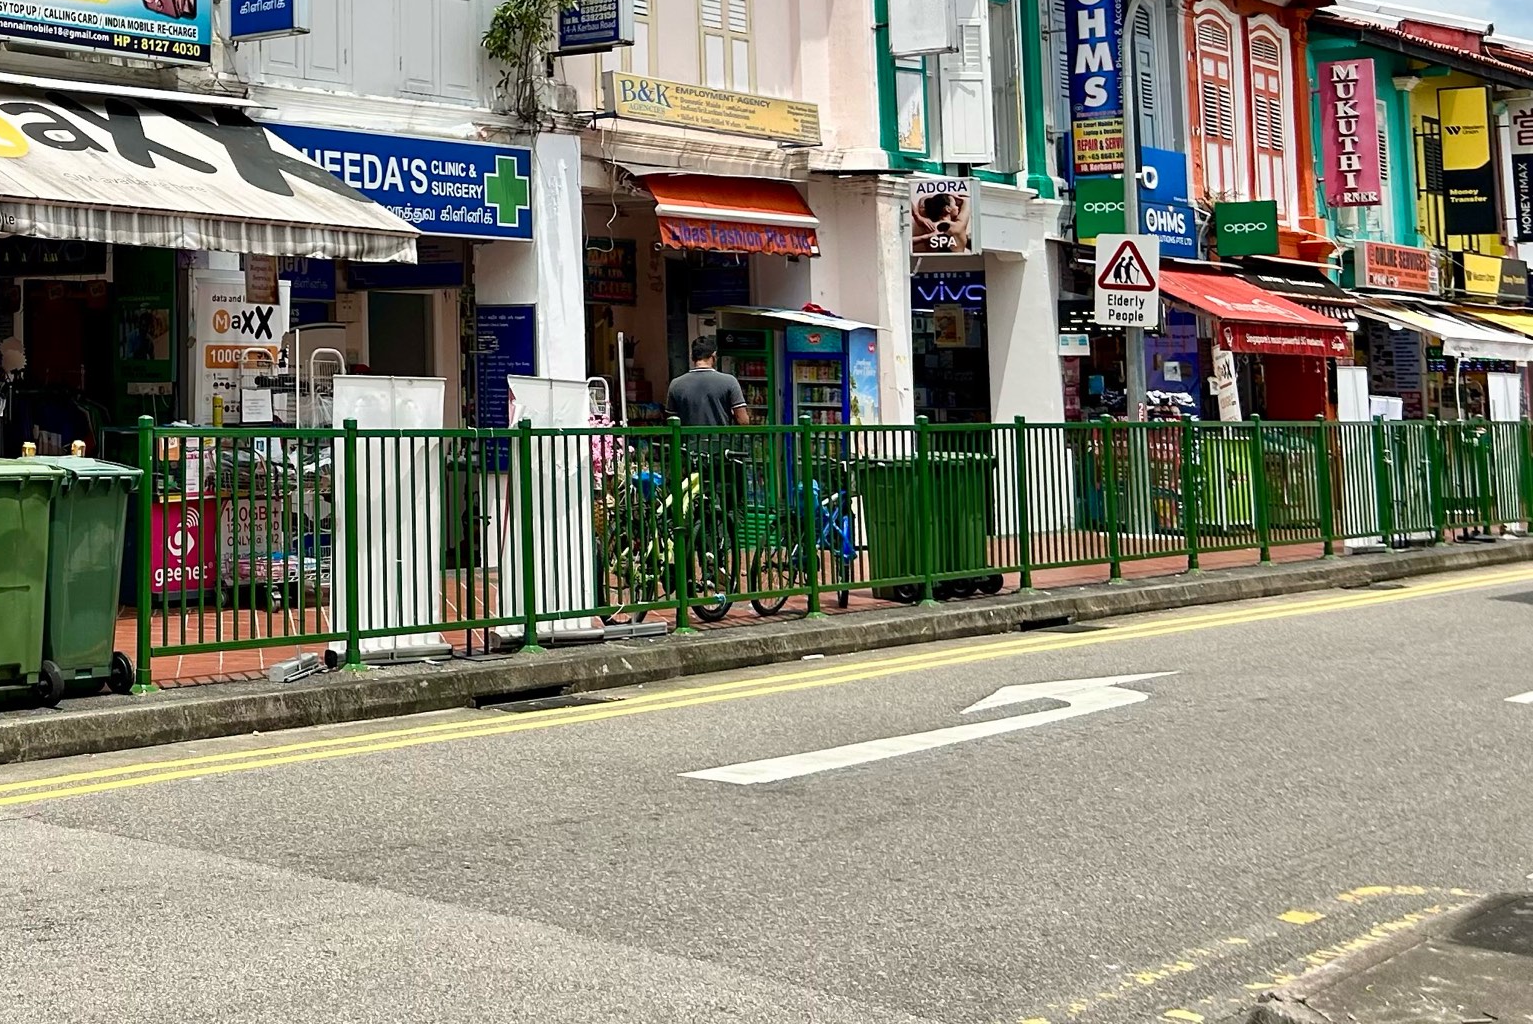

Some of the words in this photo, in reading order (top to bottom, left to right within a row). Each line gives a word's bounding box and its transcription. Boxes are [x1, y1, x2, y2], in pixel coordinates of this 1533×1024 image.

[9, 2, 24, 14] TOP
[25, 4, 37, 15] UP
[43, 7, 76, 22] CALLING
[77, 12, 98, 24] CARD
[104, 16, 126, 28] INDIA
[127, 20, 155, 33] MOBILE
[157, 25, 197, 39] RE-CHARGE
[600, 19, 616, 29] Road
[113, 34, 130, 49] HP
[141, 38, 170, 53] 8127
[172, 42, 200, 57] 4030
[620, 79, 672, 109] B&K
[675, 86, 735, 103] EMPLOYMENT
[737, 96, 771, 109] AGENCY
[1331, 63, 1362, 189] MUKUTHI
[1077, 138, 1098, 151] REPAIR
[430, 160, 467, 178] CLINIC
[468, 163, 478, 178] &
[431, 181, 484, 200] SURGERY
[916, 180, 968, 194] ADORA
[1449, 188, 1479, 196] Money
[440, 203, 494, 225] கிளினிக்
[1146, 207, 1186, 234] OHMS
[710, 223, 762, 246] Fashion
[766, 228, 786, 248] Pte
[1224, 222, 1268, 234] oppo
[930, 236, 958, 248] SPA
[212, 294, 227, 303] data
[228, 294, 242, 303] and
[1107, 294, 1145, 309] Elderly
[1108, 309, 1144, 323] People
